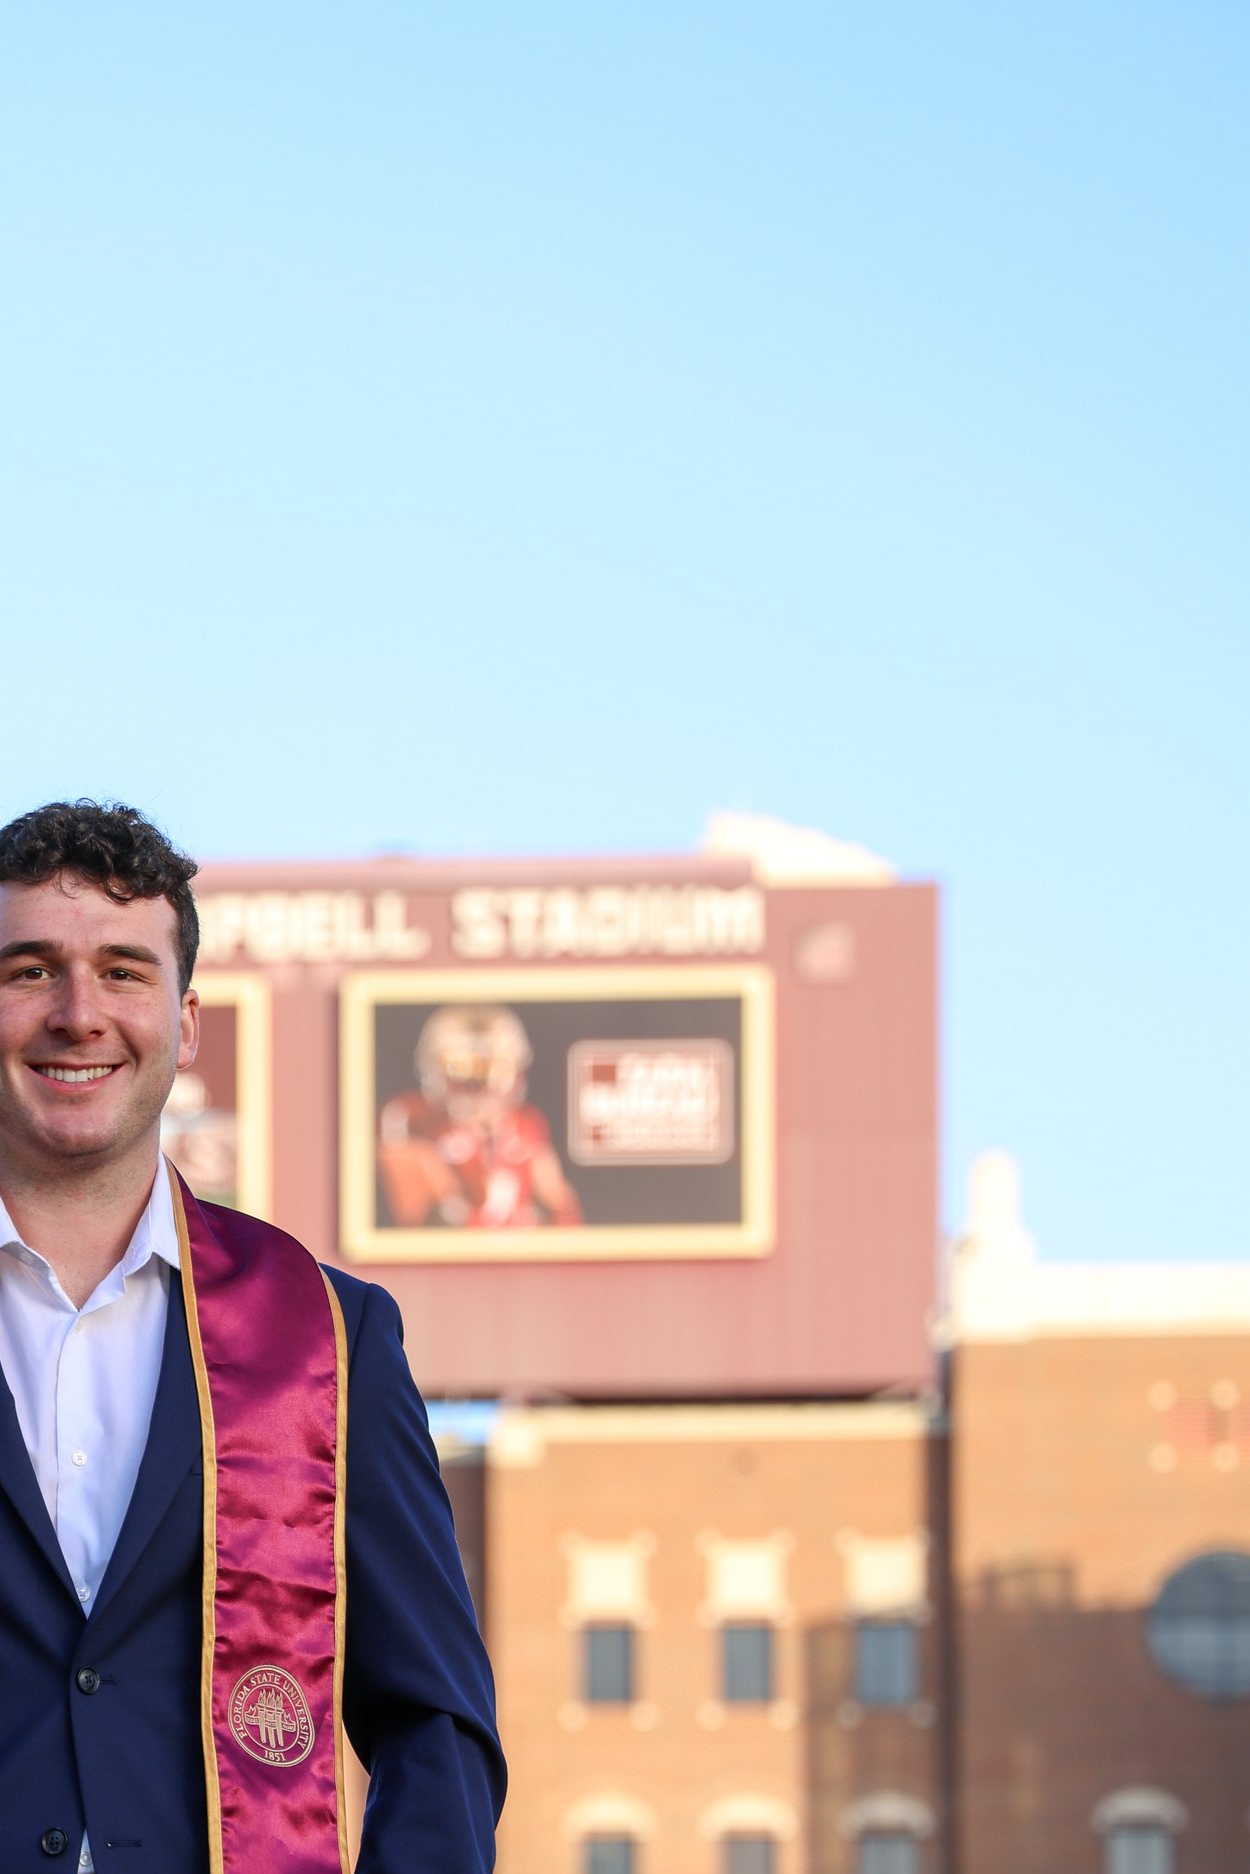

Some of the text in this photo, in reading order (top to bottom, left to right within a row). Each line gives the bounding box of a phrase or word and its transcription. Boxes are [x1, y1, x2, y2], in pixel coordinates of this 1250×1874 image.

[452, 886, 765, 957] STADIUM
[233, 1672, 310, 1750] FLORIDA STATE UNIVERSITY
[264, 1750, 286, 1762] 1851
